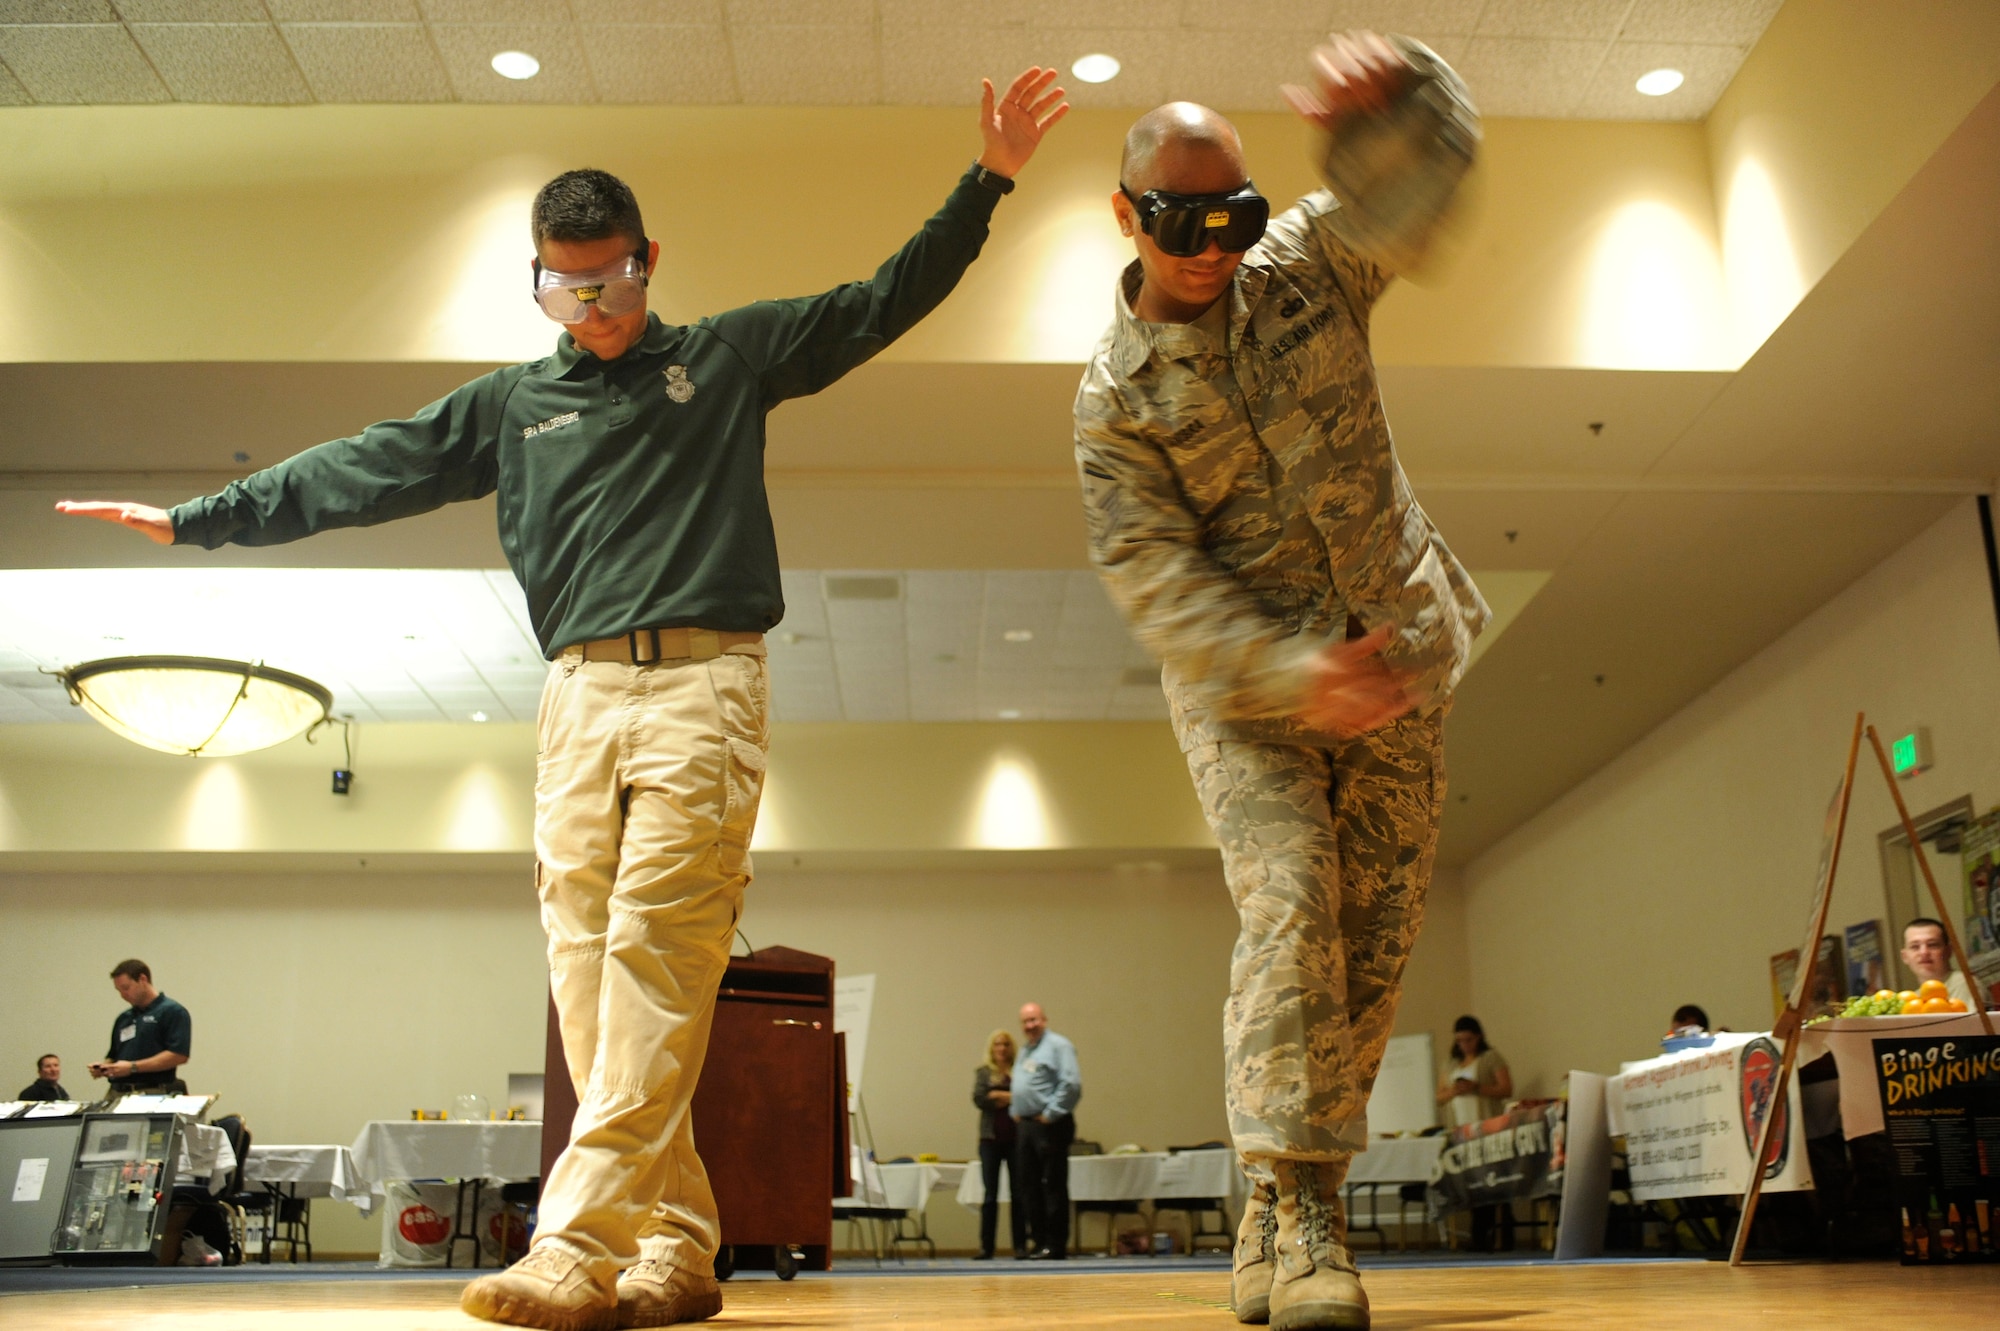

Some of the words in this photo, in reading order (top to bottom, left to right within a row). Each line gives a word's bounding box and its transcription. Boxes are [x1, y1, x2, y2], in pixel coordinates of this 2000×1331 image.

[1293, 324, 1313, 344] AIR
[1881, 1042, 1956, 1077] Binge
[1887, 1048, 2000, 1105] DRINKING
